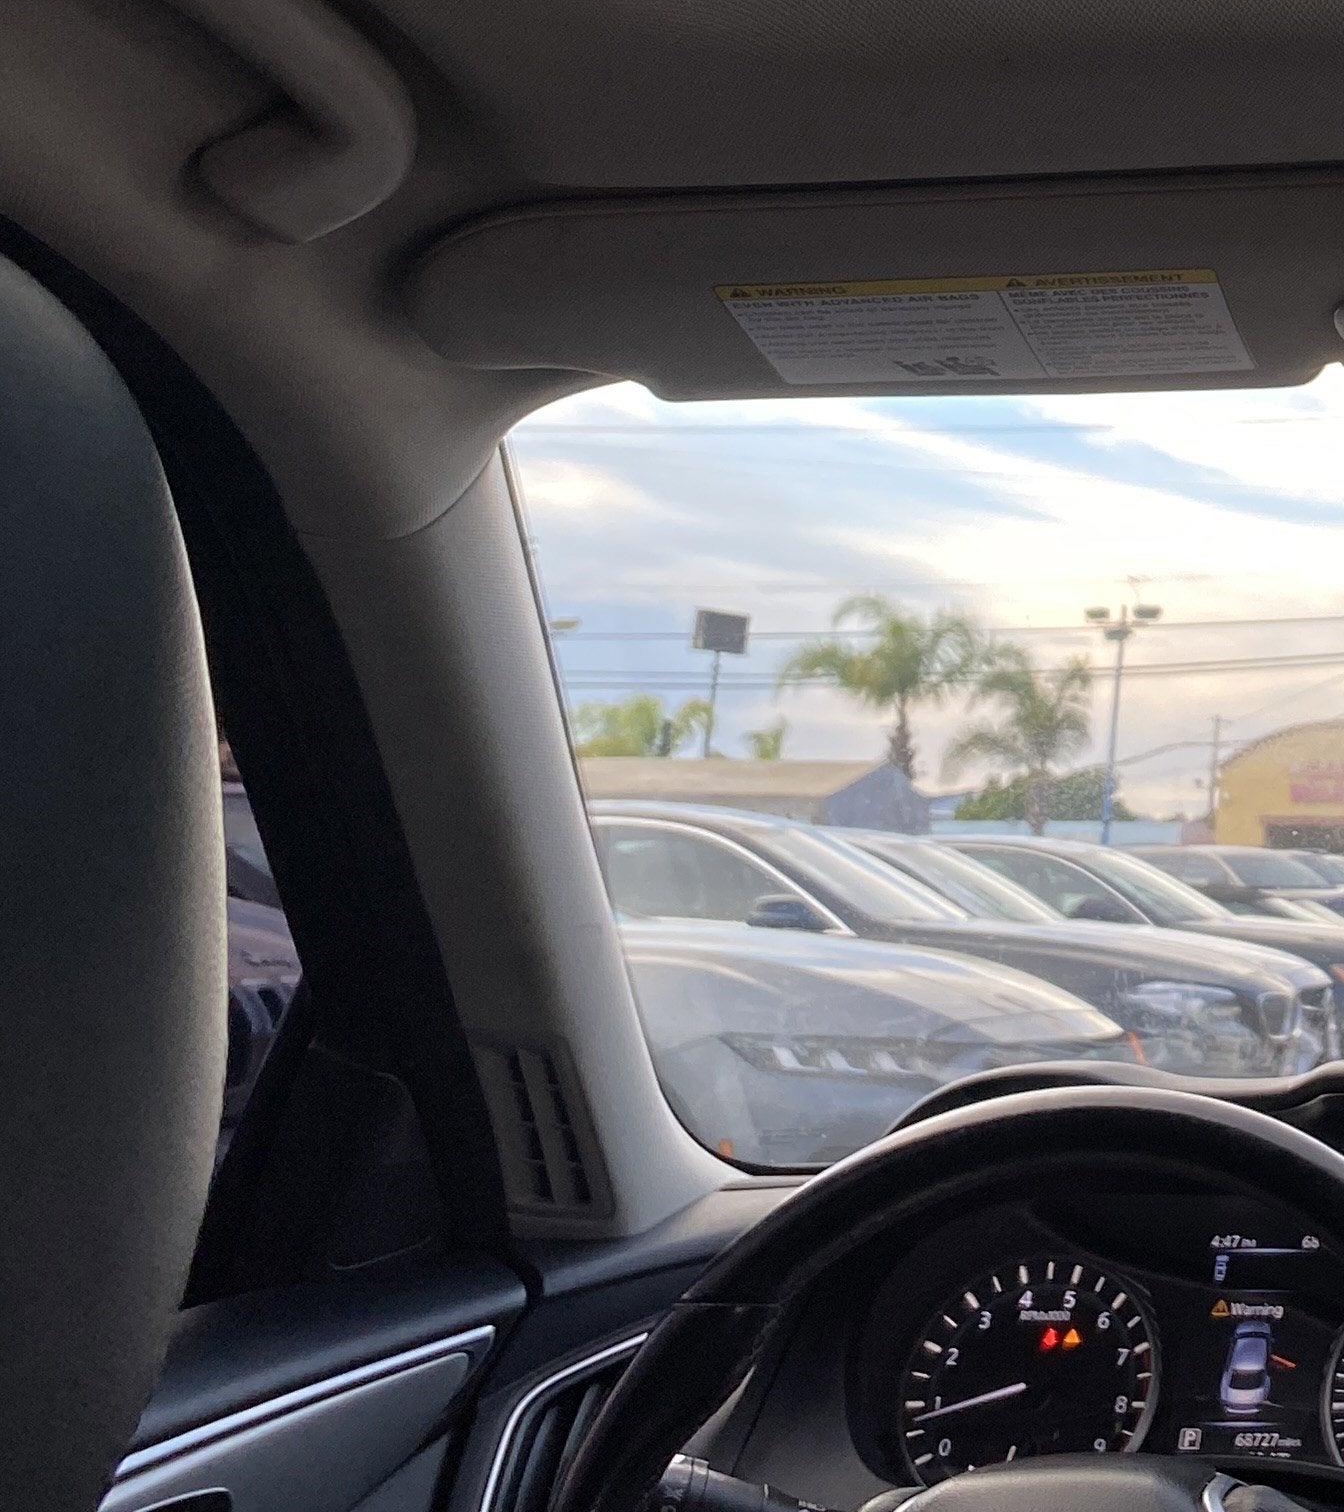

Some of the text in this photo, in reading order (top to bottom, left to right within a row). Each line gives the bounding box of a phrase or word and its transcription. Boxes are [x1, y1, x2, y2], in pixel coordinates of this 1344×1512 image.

[756, 286, 846, 296] WARNING
[1210, 1234, 1241, 1249] 4:47
[1018, 1290, 1033, 1308] 4
[1063, 1290, 1077, 1308] 5
[1230, 1302, 1285, 1320] Warning
[978, 1311, 992, 1330] 3
[1097, 1312, 1111, 1330] 6
[945, 1347, 959, 1366] 2
[1116, 1348, 1130, 1366] 7
[1114, 1395, 1128, 1414] 8
[938, 1437, 951, 1457] 0
[1235, 1433, 1280, 1448] 68727
